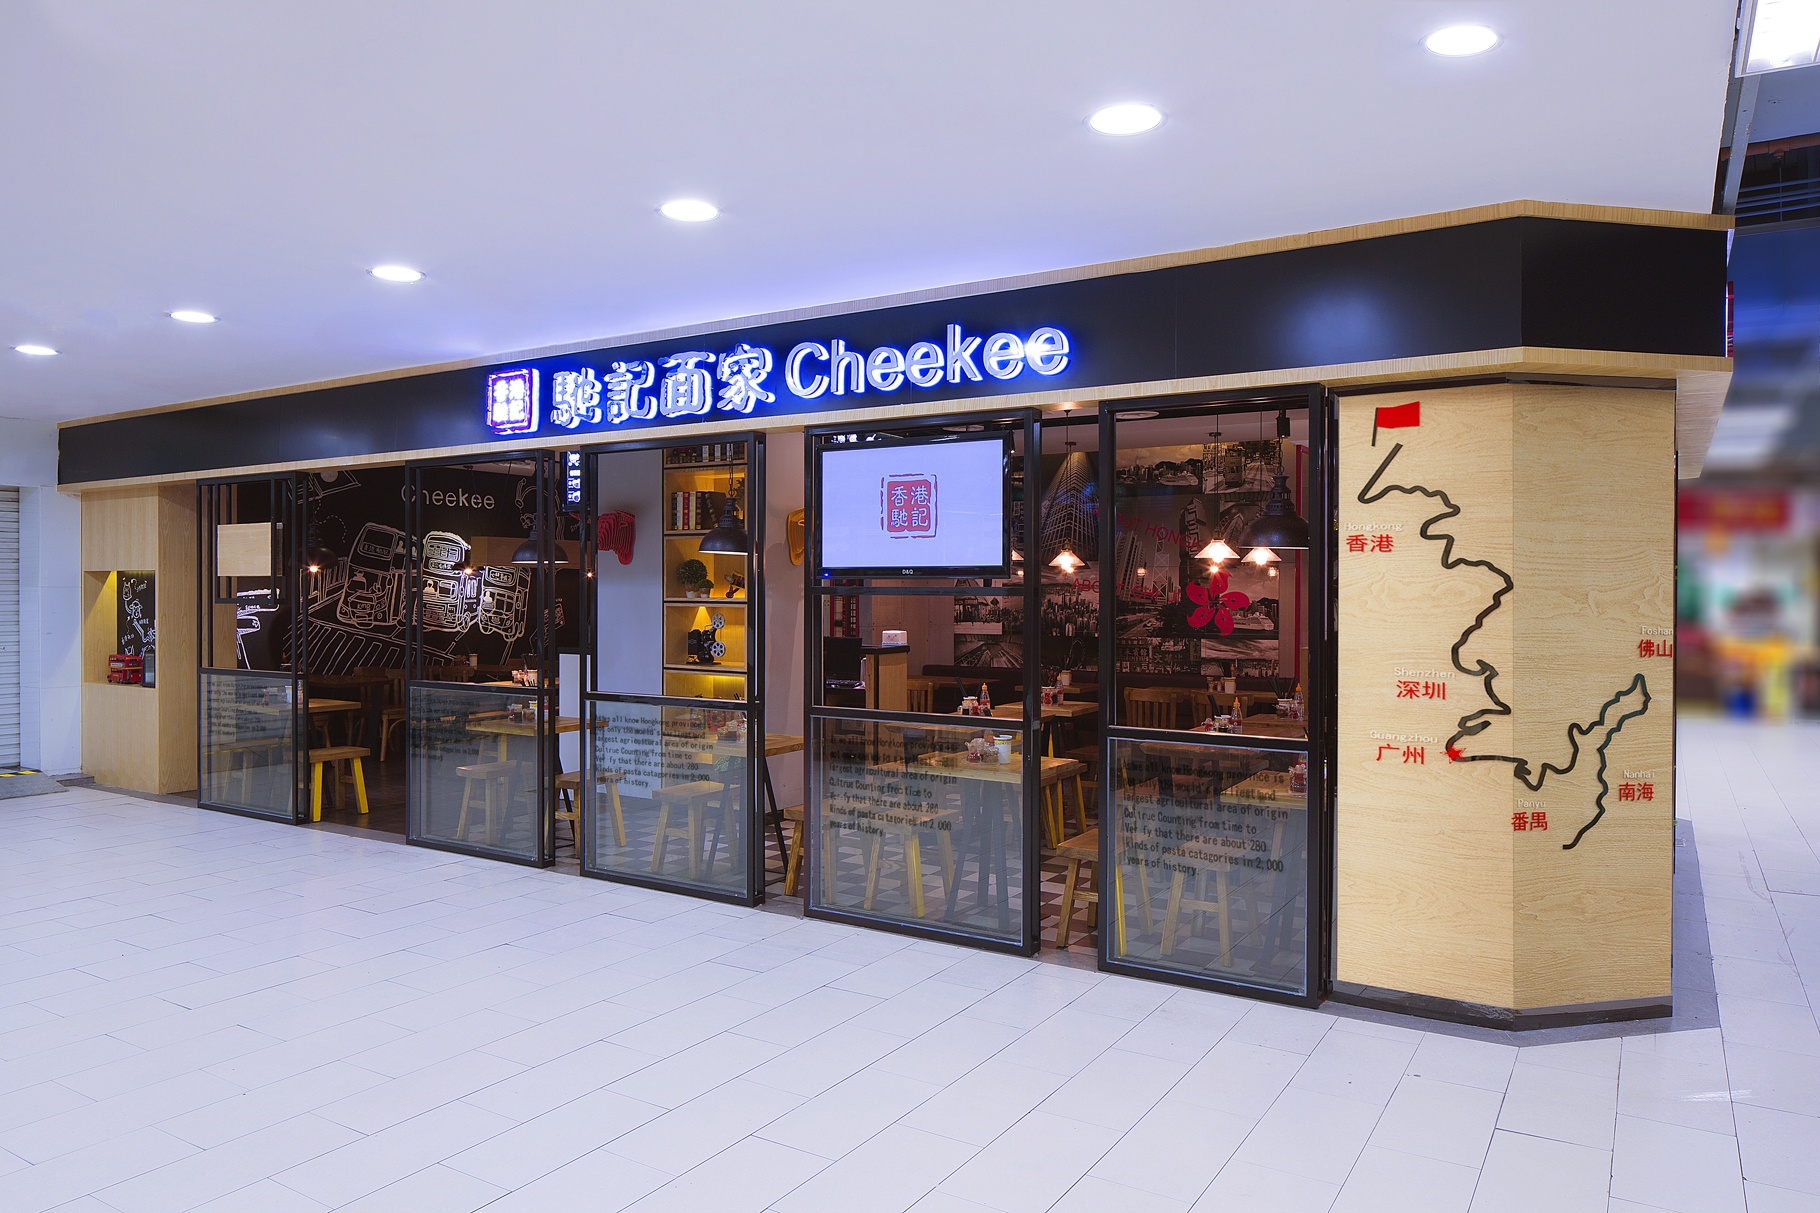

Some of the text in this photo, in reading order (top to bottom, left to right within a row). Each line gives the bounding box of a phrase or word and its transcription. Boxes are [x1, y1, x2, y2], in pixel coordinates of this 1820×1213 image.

[550, 323, 1070, 429] 馳記面家 Cheekee
[890, 485, 929, 507] 香港
[890, 507, 929, 528] 馳記
[1343, 521, 1403, 532] Hongkong
[1345, 533, 1394, 553] 香港
[1640, 625, 1674, 635] Foshan
[1637, 639, 1673, 658] 佛山
[1393, 666, 1455, 679] Shenzhen
[1396, 680, 1446, 700] 深圳
[625, 716, 640, 724] know
[607, 726, 621, 734] only
[1369, 729, 1438, 743] Guangzhou
[621, 747, 649, 757] Counting
[691, 742, 713, 750] origin
[1376, 743, 1425, 765] 广州
[624, 768, 641, 776] pasta
[634, 758, 652, 766] there
[667, 761, 684, 769] about
[902, 770, 917, 780] area
[920, 770, 928, 780] of
[930, 772, 957, 784] origin
[1274, 774, 1284, 784] is
[1623, 770, 1655, 779] Nanhai
[855, 780, 885, 794] Counting
[924, 787, 932, 799] to
[1618, 782, 1654, 801] 南海
[852, 793, 866, 805] that
[869, 795, 887, 808] there
[889, 800, 901, 808] are
[903, 800, 923, 812] about
[1123, 790, 1288, 820] largest agricultural area of origin
[1517, 799, 1546, 809] Panyu
[848, 806, 856, 816] of
[857, 810, 876, 821] pasta
[919, 817, 928, 828] in
[848, 820, 856, 830] of
[1123, 804, 1257, 835] Cultrue Counting from time to
[1511, 811, 1548, 831] 番禺
[1154, 827, 1173, 840] that
[1176, 828, 1200, 843] there
[1202, 836, 1218, 846] are
[1221, 836, 1247, 850] about
[1249, 839, 1267, 853] 280
[1125, 838, 1284, 874] kinds of pasta catagories in 2,000
[1126, 854, 1200, 877] years of history.
